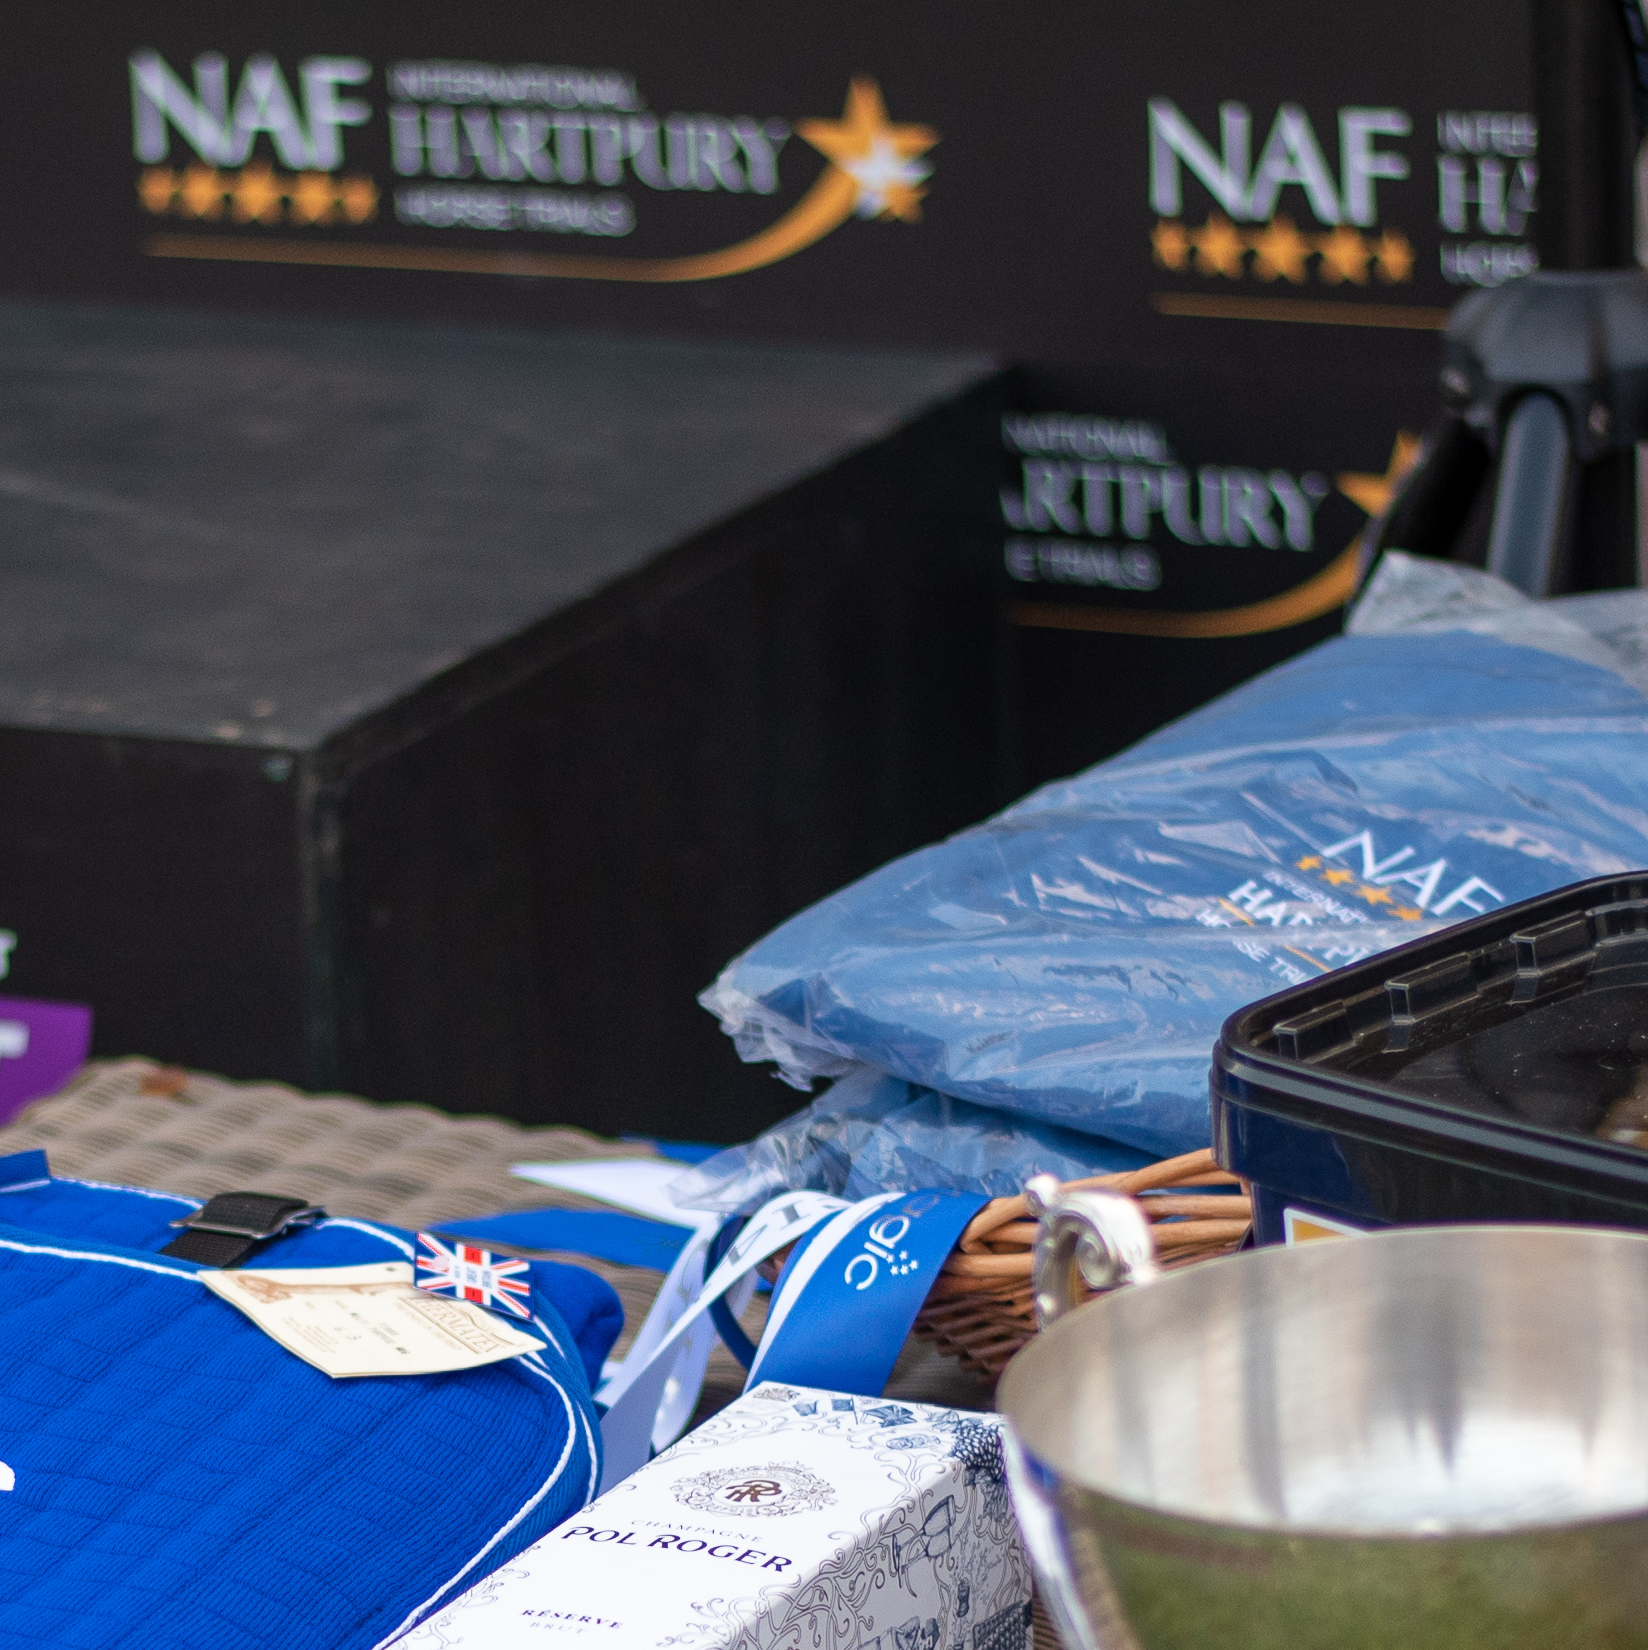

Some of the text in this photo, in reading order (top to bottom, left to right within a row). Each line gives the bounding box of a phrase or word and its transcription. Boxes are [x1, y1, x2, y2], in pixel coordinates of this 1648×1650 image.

[129, 48, 372, 172] NAF
[389, 103, 792, 195] HARTPURY
[1147, 97, 1413, 228] NAF
[1321, 828, 1505, 917] NAF
[561, 1526, 792, 1572] POL ROGER
[631, 1519, 763, 1542] CHAMPAGNE
